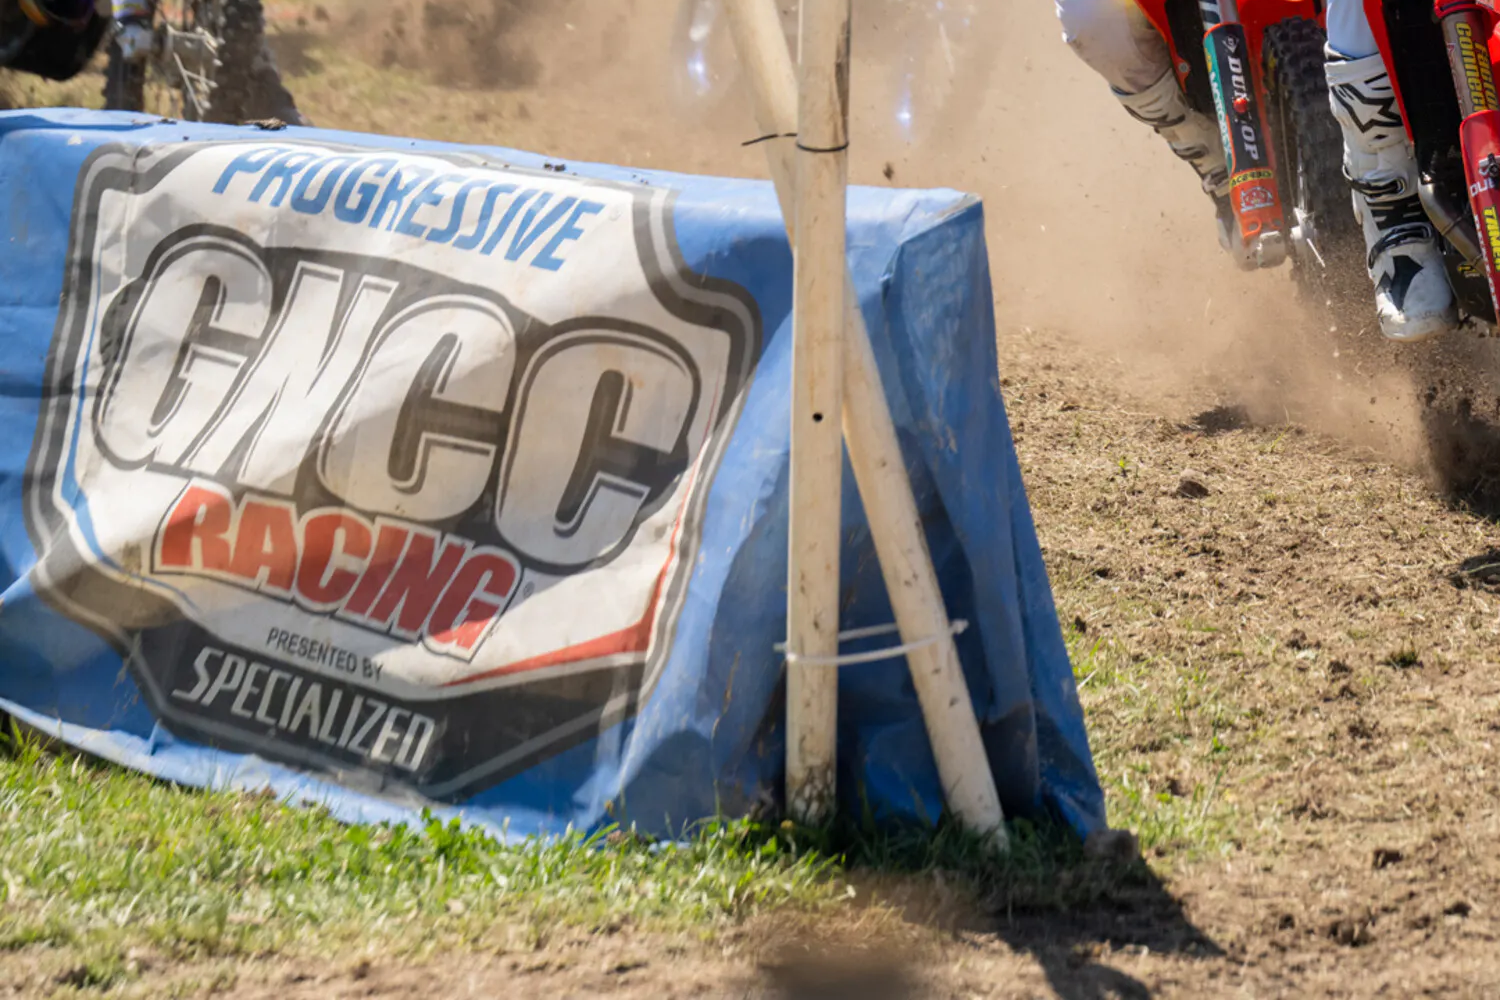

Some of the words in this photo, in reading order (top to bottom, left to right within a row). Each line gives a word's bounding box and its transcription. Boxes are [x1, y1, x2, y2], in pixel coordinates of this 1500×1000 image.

[211, 145, 606, 272] PROGRESSIVE
[94, 230, 700, 565] GNCC
[157, 482, 518, 655] RACING
[172, 646, 436, 773] SPECIALIZED
[265, 626, 358, 673] PRESENTED
[361, 657, 384, 681] BY
